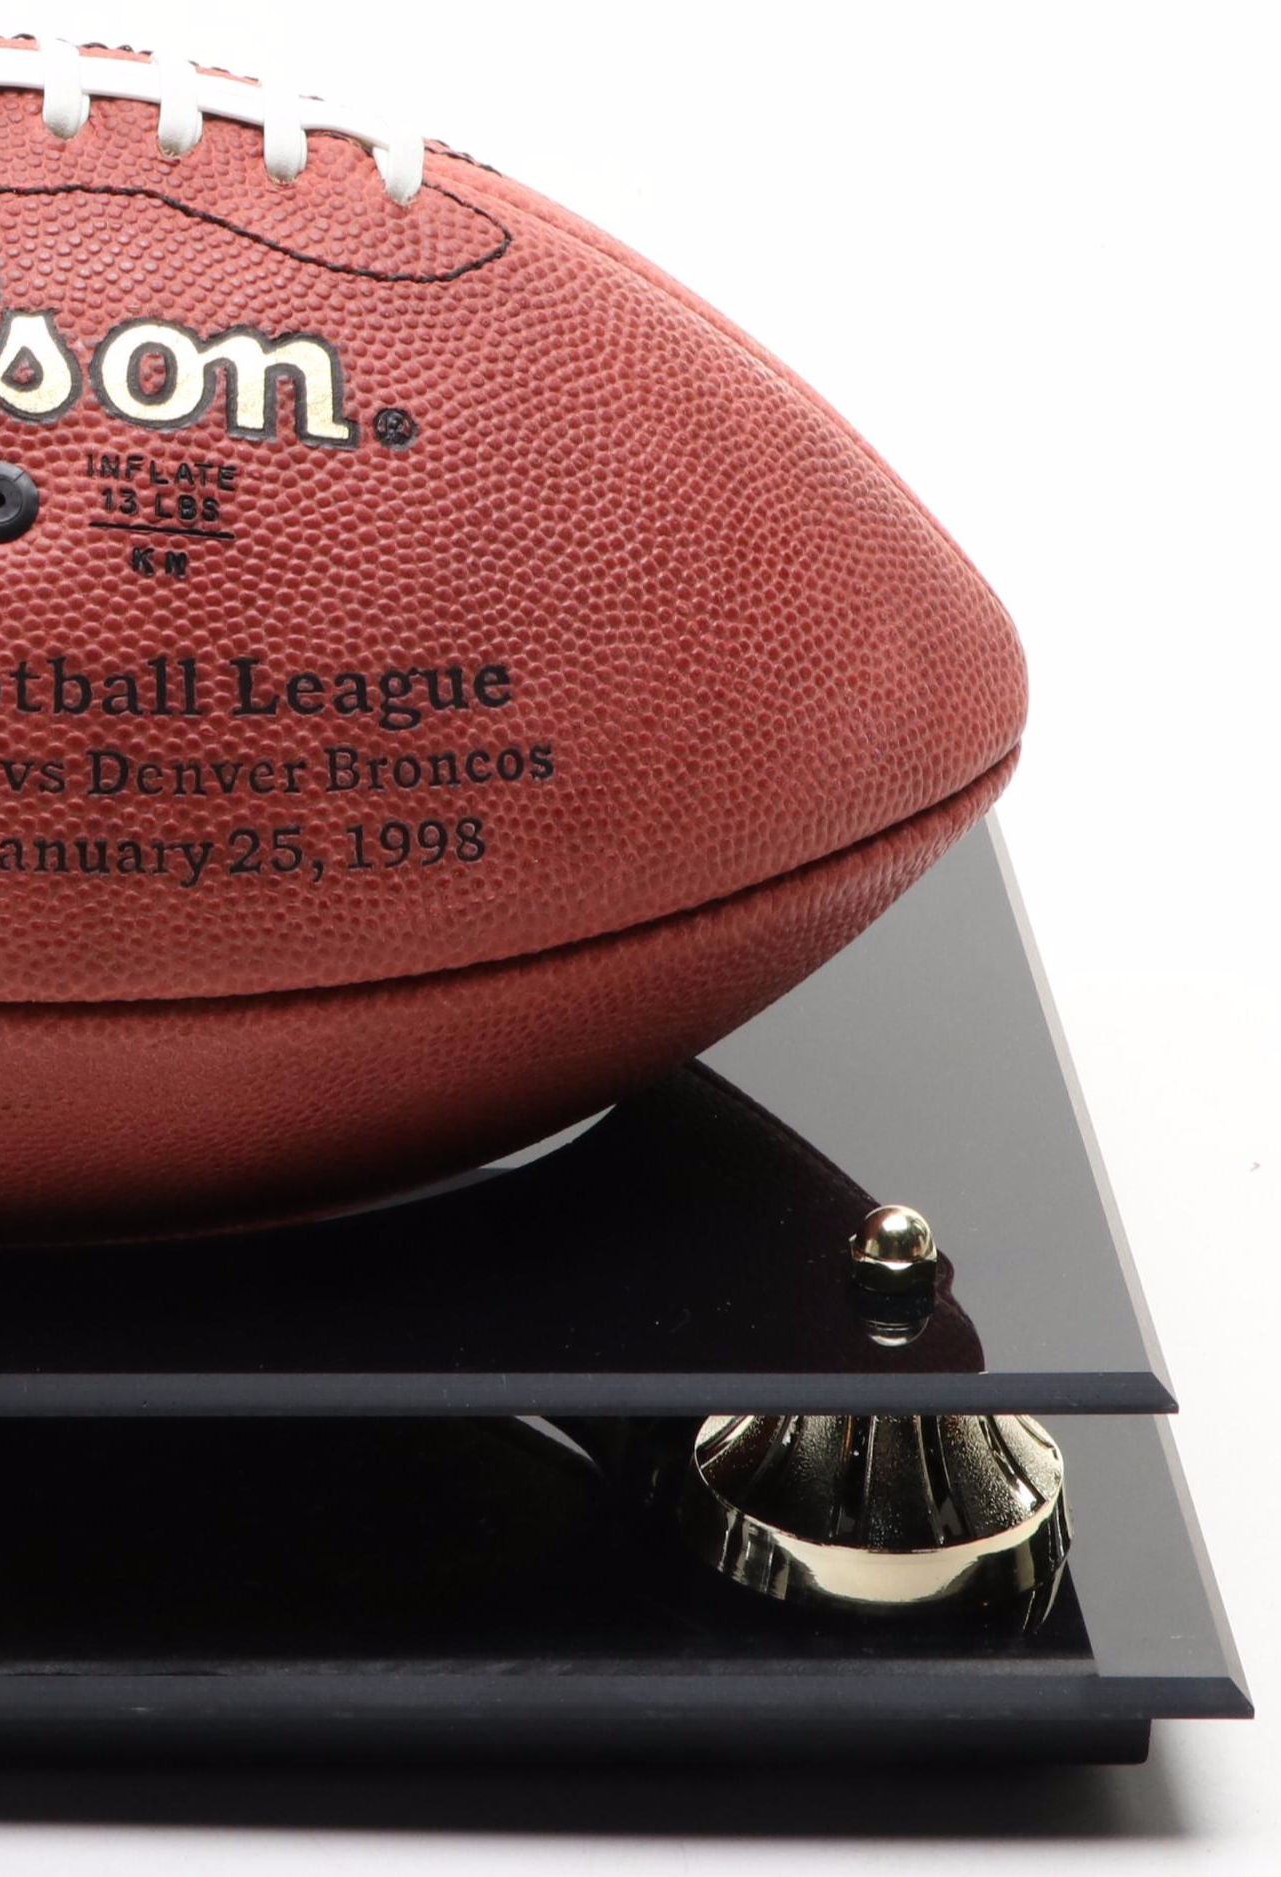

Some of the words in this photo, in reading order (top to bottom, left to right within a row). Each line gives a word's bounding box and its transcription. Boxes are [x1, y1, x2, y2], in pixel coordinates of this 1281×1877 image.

[87, 453, 237, 492] INFLATE
[102, 487, 138, 514] 13
[155, 493, 219, 521] LBS
[229, 657, 513, 731] League
[0, 757, 66, 794] vs
[87, 749, 307, 796] Denver
[324, 742, 554, 793] Broncos
[228, 825, 326, 883] 25,
[346, 816, 487, 869] 1998
